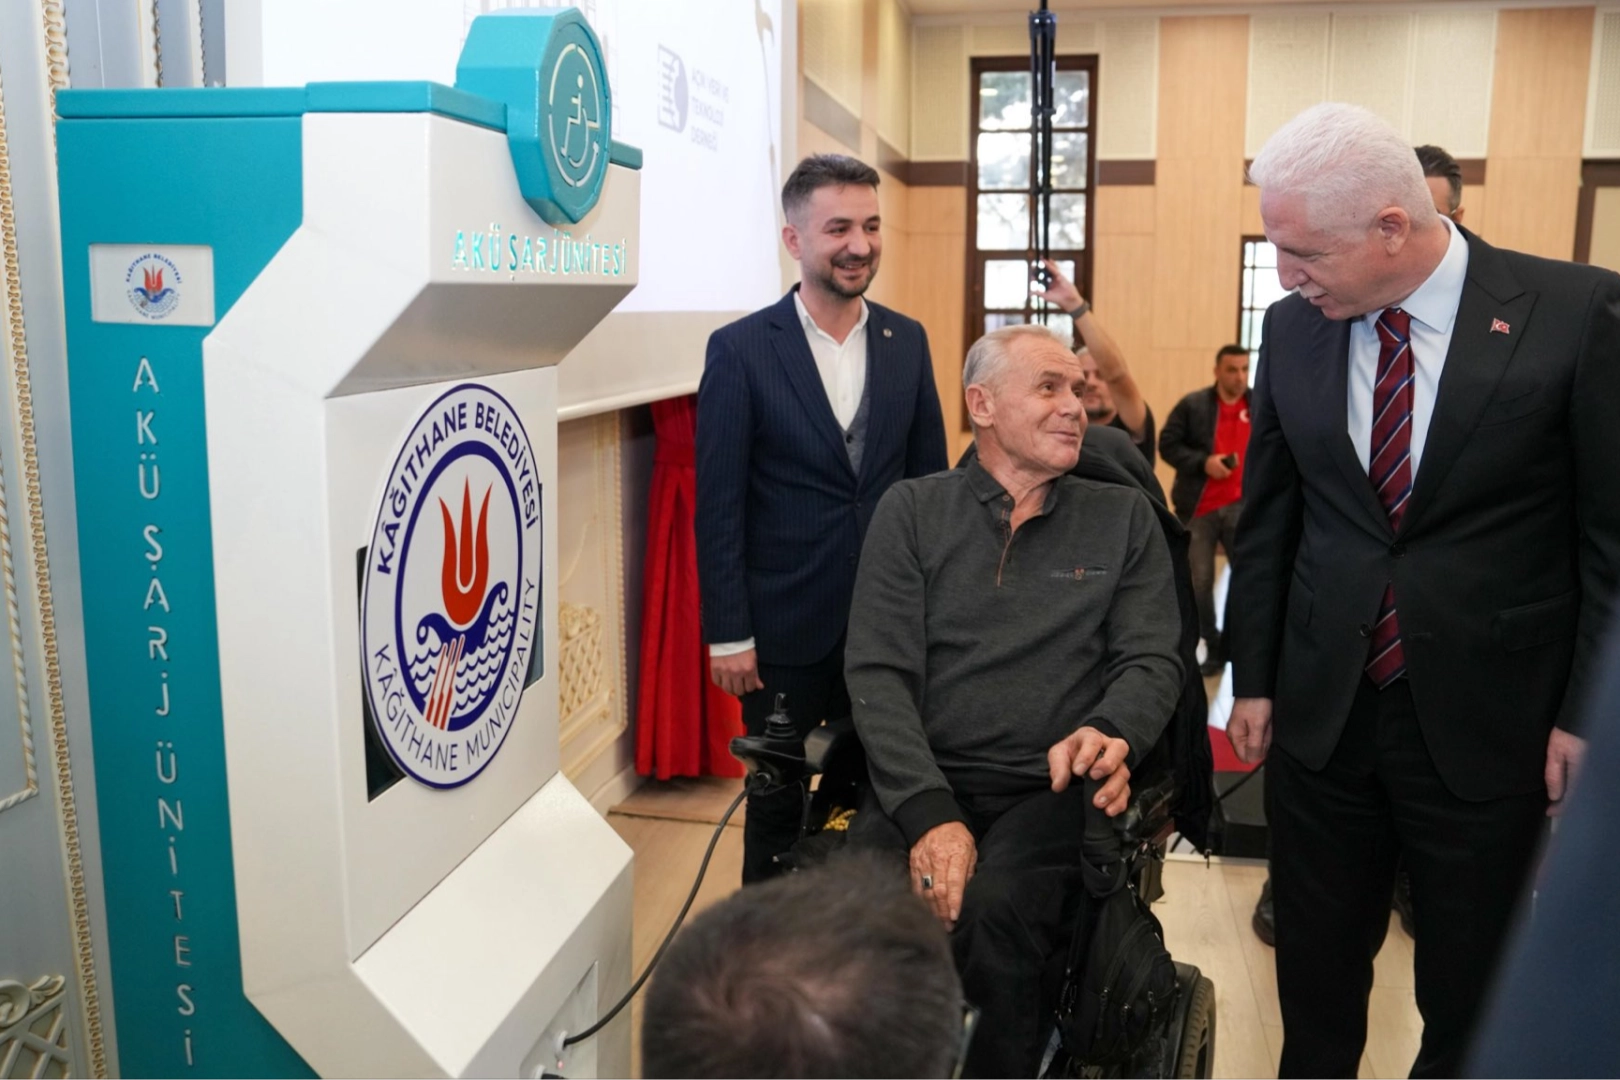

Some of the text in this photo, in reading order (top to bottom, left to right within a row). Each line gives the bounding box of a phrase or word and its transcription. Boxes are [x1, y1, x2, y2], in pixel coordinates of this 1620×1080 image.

[452, 222, 501, 272] AKÜ
[475, 402, 538, 530] BELEDİYESİ
[133, 356, 195, 1066] AKÜ ŞARJ ÜNİTESİ
[466, 578, 536, 765] MUNICIPALITY
